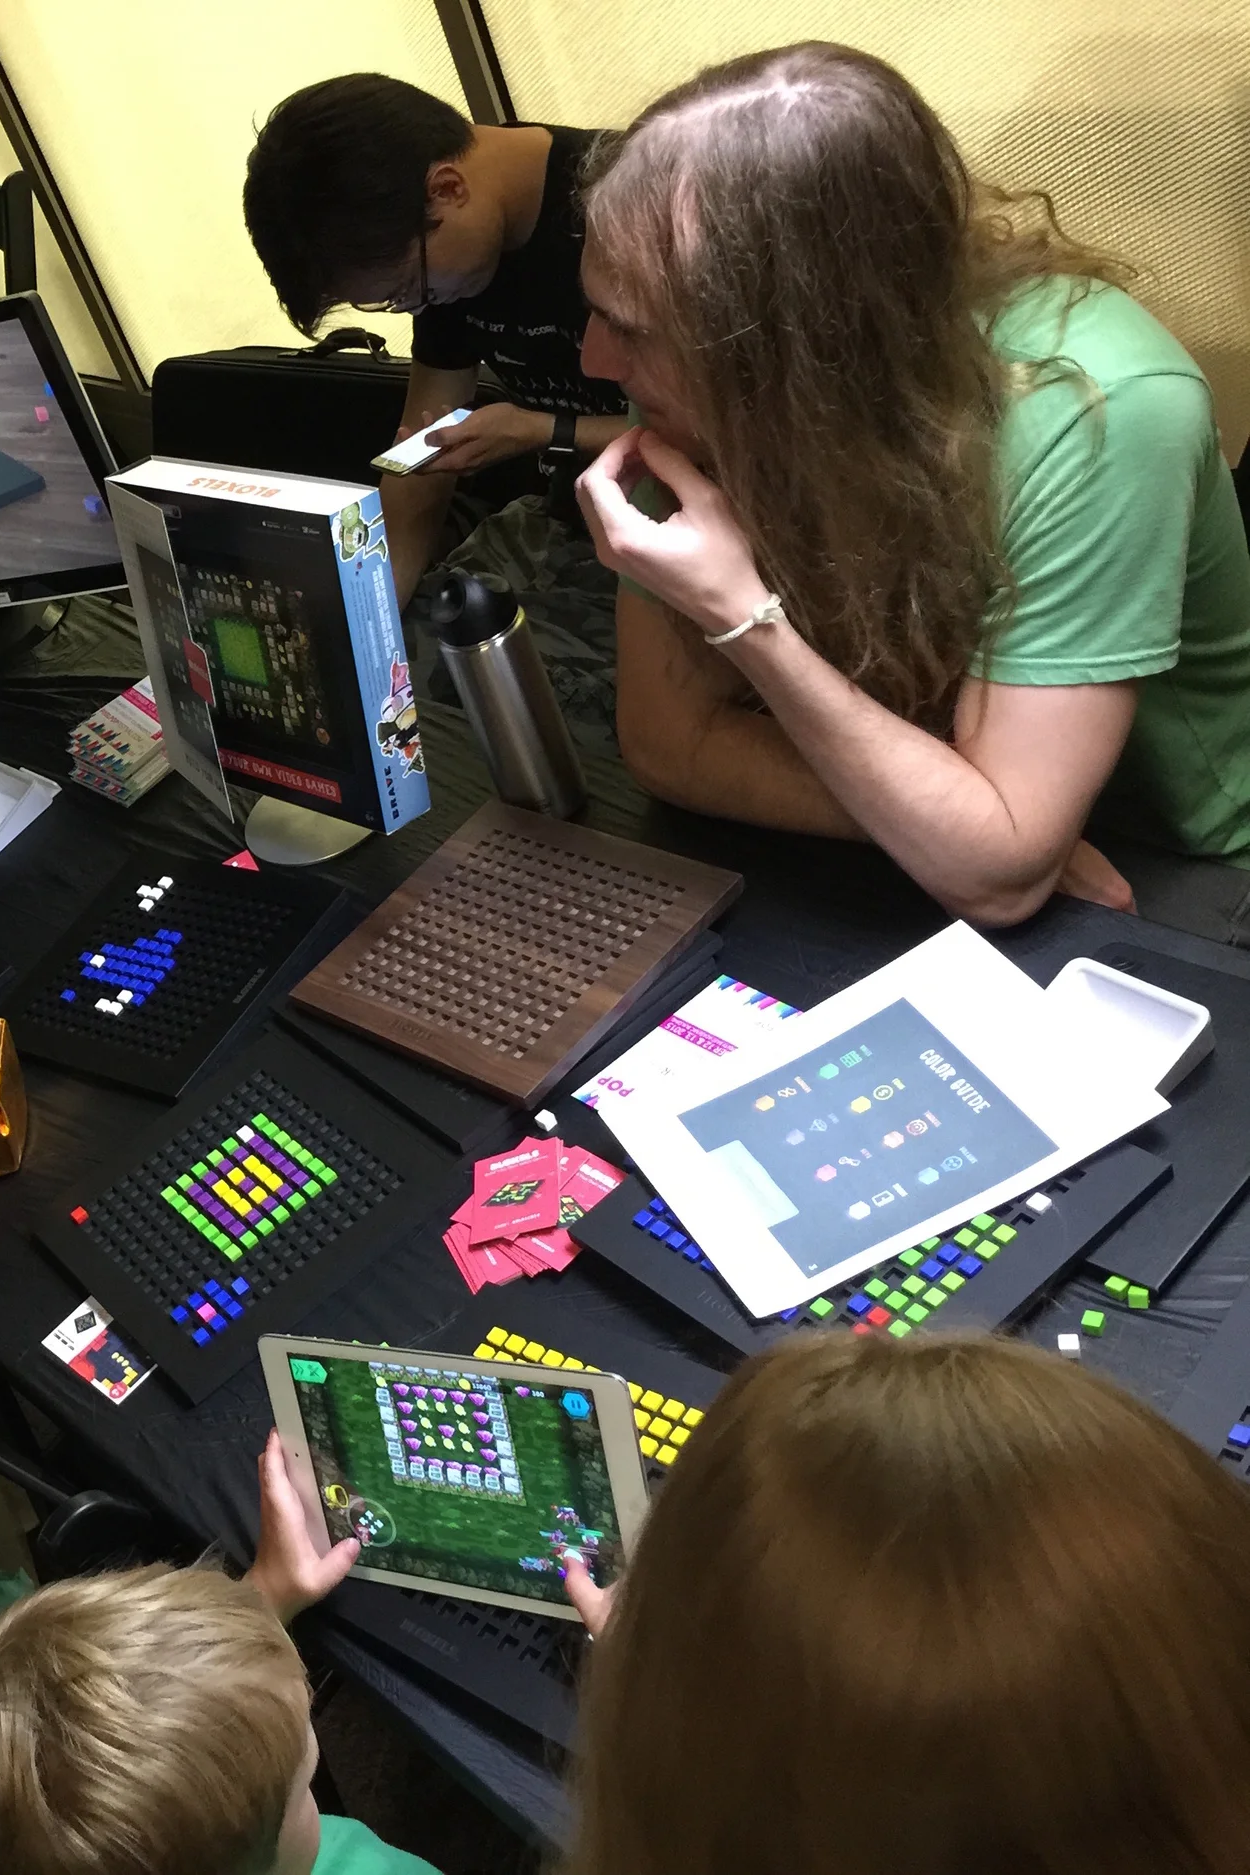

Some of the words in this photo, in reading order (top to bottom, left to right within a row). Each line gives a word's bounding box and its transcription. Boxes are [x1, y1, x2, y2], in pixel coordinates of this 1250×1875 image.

[187, 476, 282, 499] BLOXELS
[274, 767, 303, 787] VIDEO
[305, 778, 337, 797] GAMES
[382, 765, 402, 820] BRAVE
[664, 1020, 686, 1036] 2015
[597, 1073, 635, 1099] POP
[919, 1046, 958, 1083] COLOR
[949, 1076, 991, 1116] GUIDE
